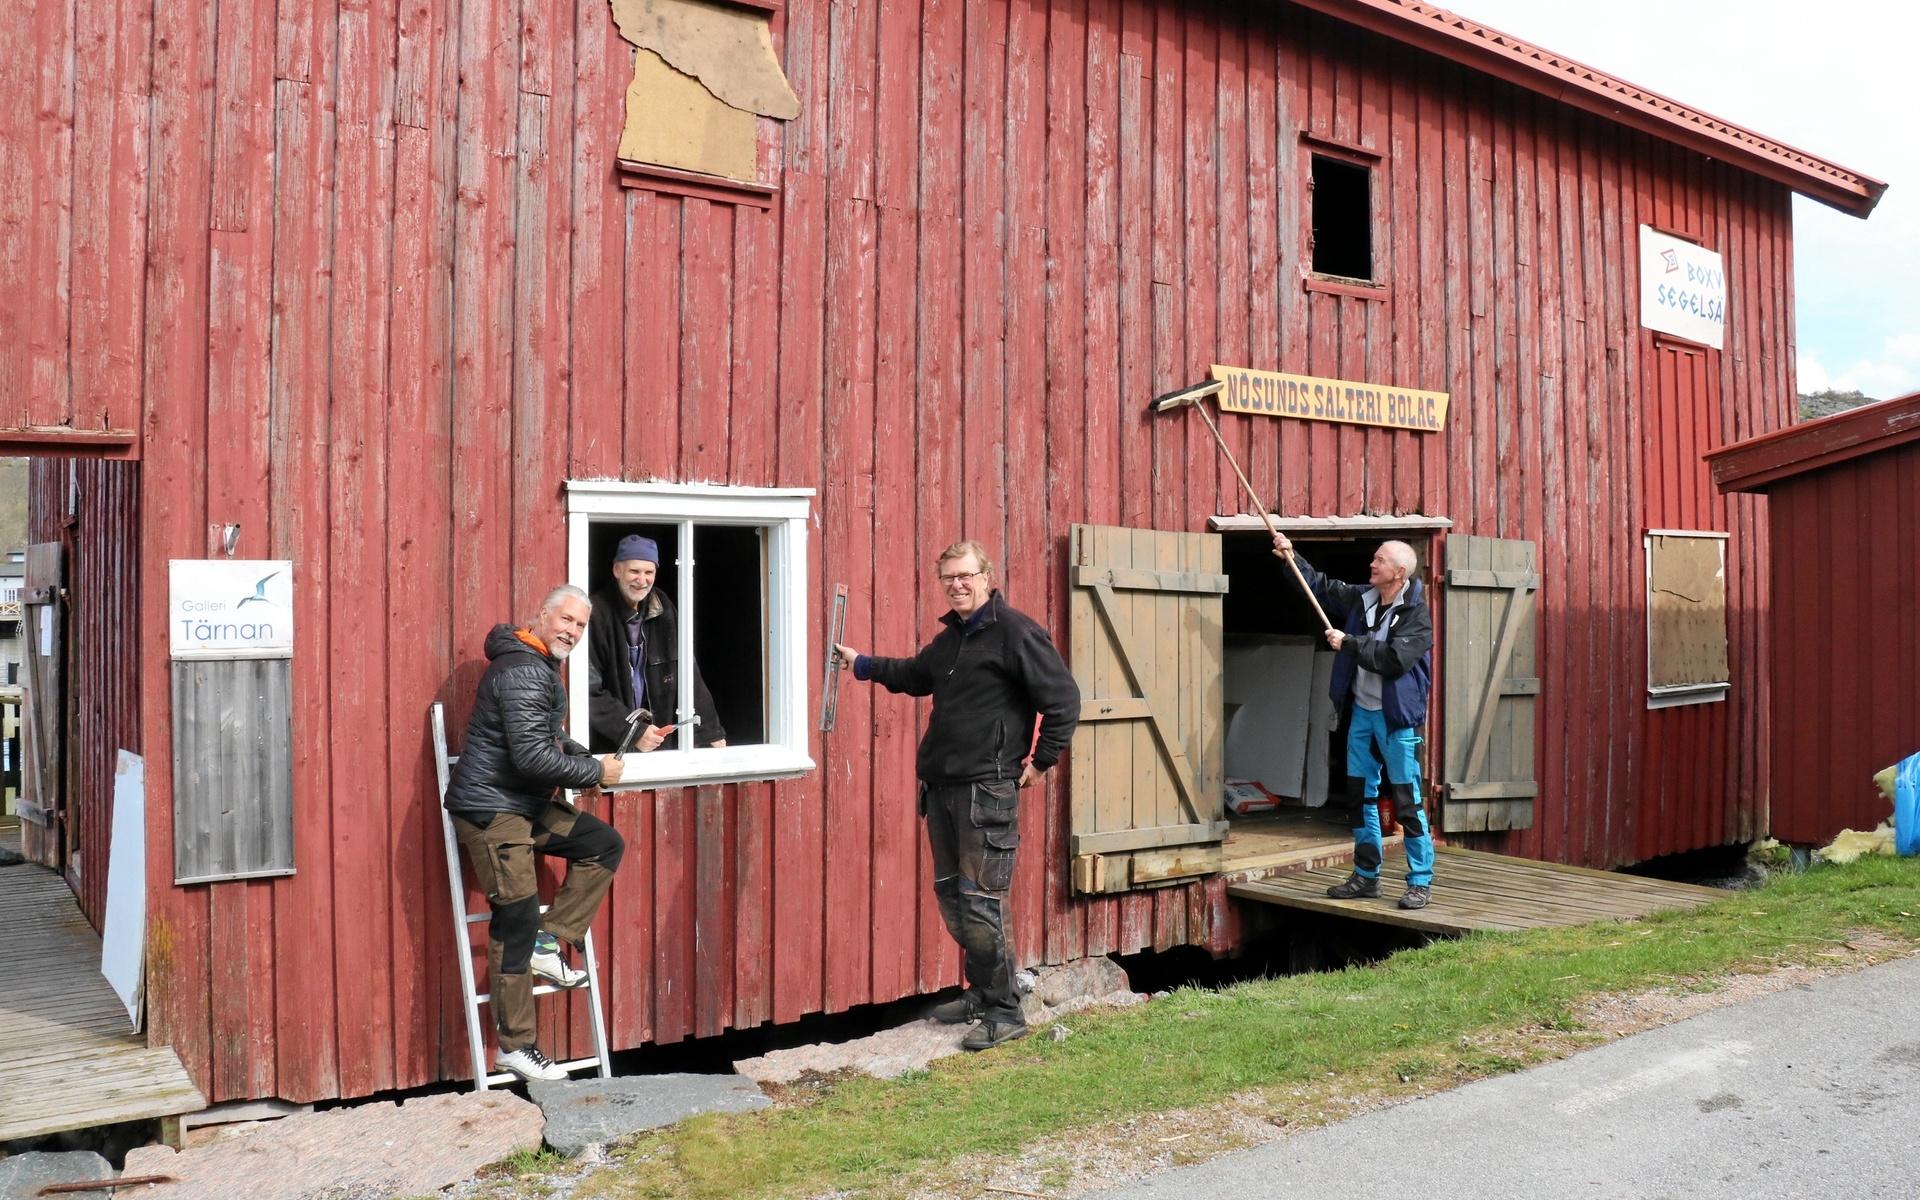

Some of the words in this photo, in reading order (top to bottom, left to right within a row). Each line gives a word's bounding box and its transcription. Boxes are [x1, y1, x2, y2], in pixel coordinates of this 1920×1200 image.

[1227, 372, 1310, 415] NÖSUNDS
[1314, 384, 1382, 423] SALTERI
[181, 600, 226, 612] Galleri
[181, 619, 273, 641] Tärnan
